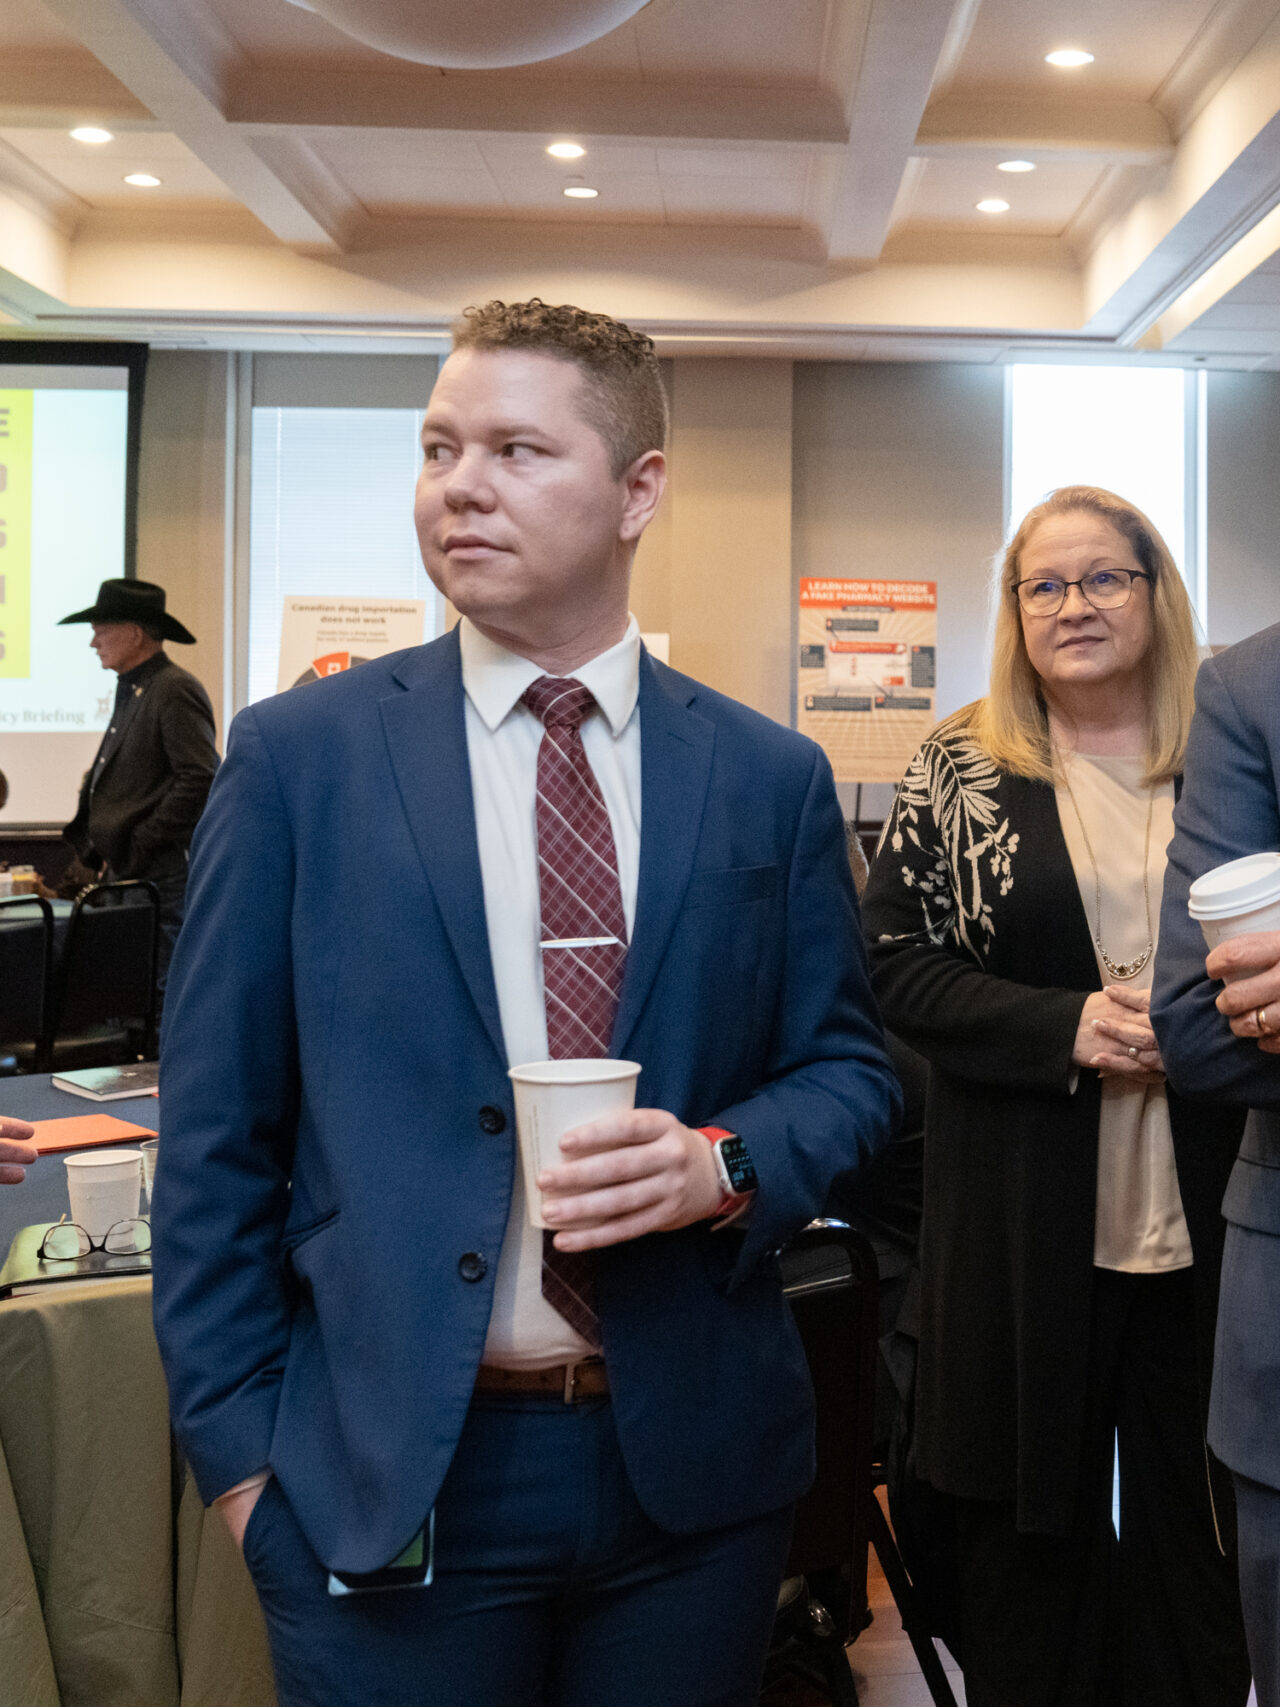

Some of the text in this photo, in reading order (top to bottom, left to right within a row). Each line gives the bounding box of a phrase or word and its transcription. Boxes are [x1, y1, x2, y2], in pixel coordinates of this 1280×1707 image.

[808, 582, 929, 594] LEARN HOW TO DECODE
[802, 591, 935, 604] A FAKE PHARMACY WEBSITE
[291, 603, 417, 614] Canadian drug importation
[320, 616, 387, 624] does not work
[23, 709, 86, 726] Briefing
